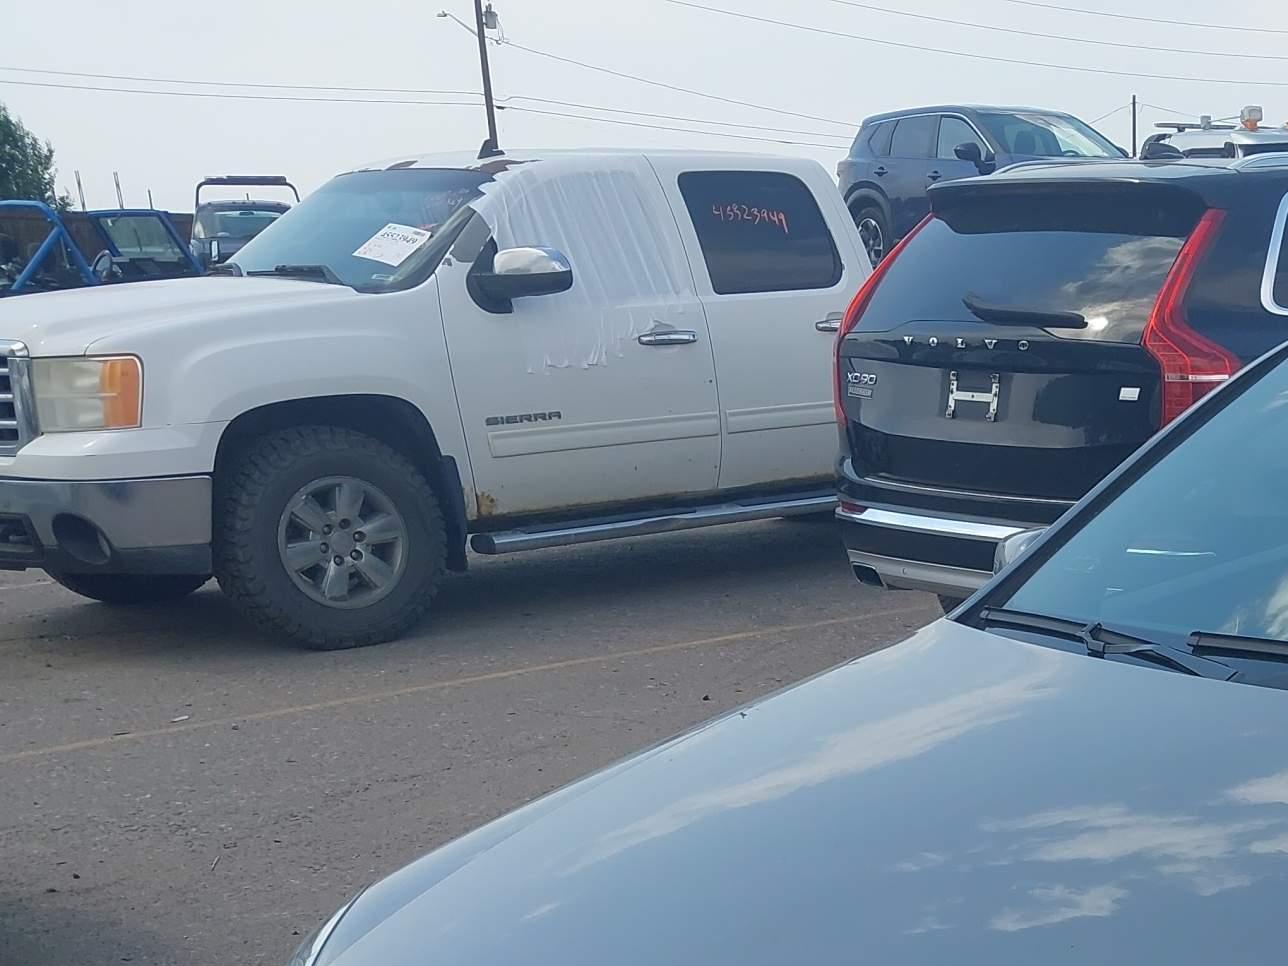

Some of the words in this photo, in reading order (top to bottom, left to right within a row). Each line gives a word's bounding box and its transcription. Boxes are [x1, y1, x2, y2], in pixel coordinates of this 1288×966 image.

[903, 336, 1030, 351] VOLVO
[847, 372, 877, 385] XC90
[485, 411, 561, 426] SIERRA
